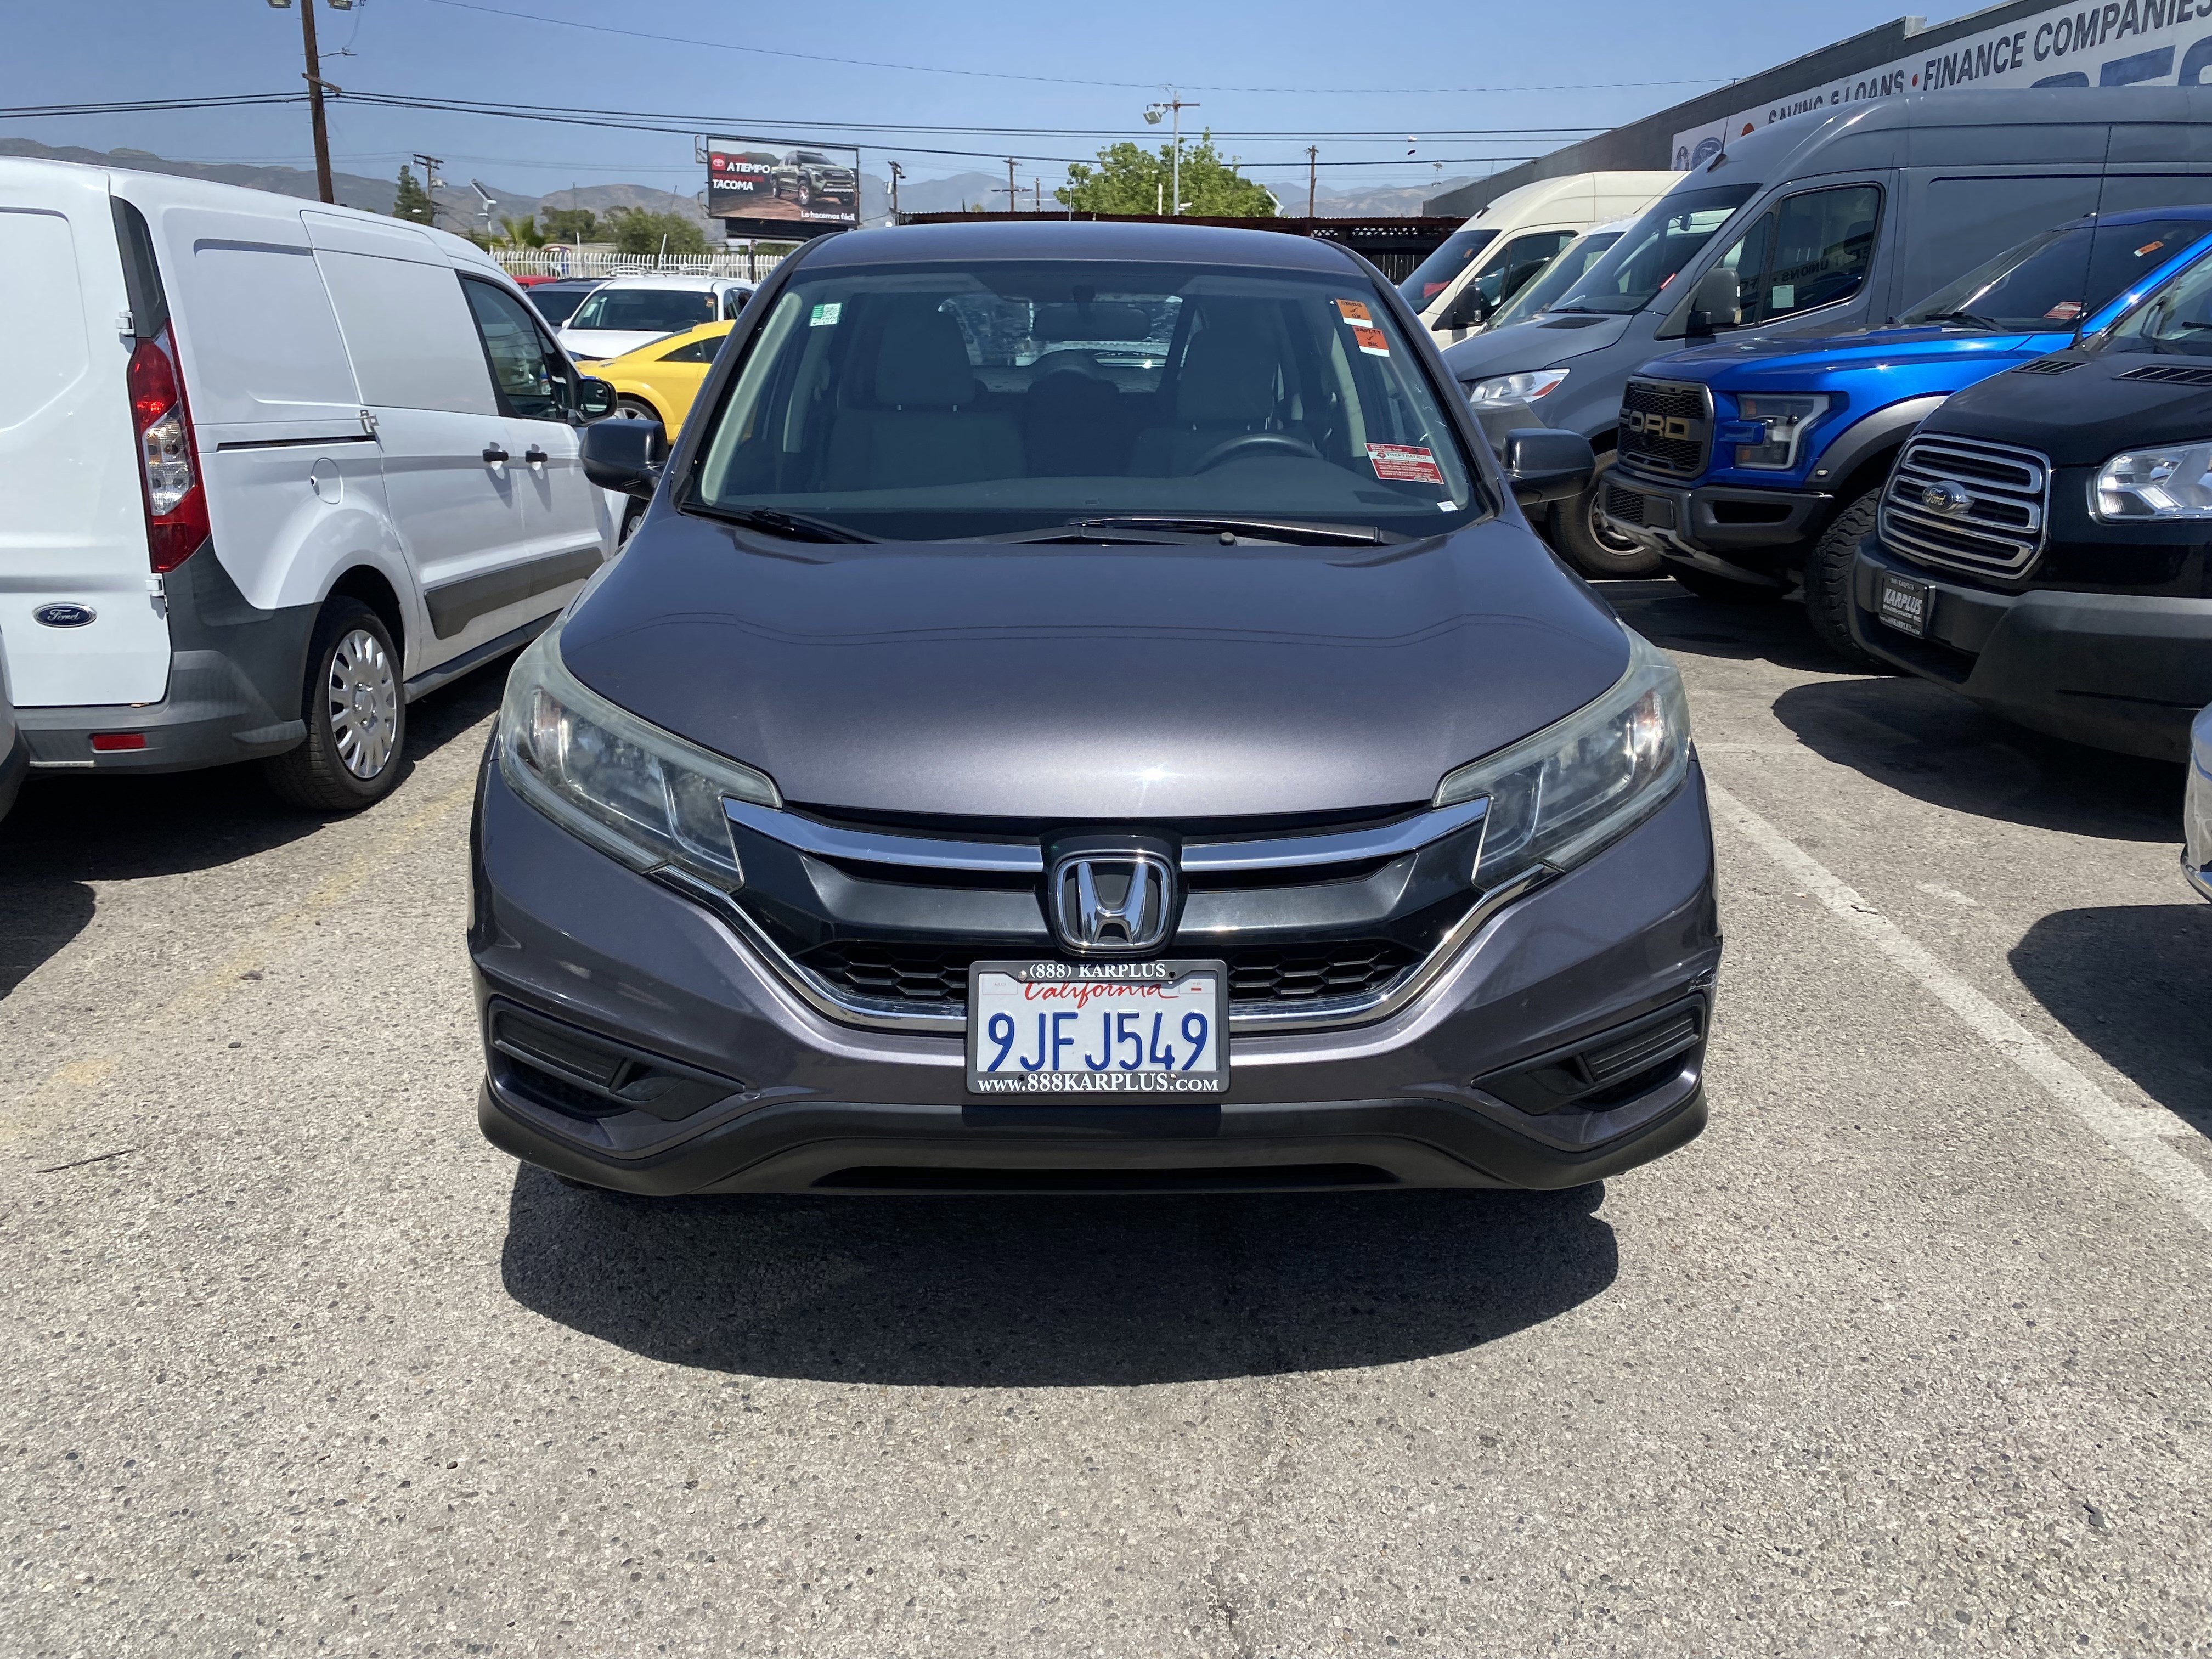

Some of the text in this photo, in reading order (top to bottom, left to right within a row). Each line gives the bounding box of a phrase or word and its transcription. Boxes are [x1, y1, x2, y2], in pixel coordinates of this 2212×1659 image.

[1845, 69, 1904, 103] LOANS
[1923, 31, 2027, 91] FINANCE
[727, 162, 770, 174] A TIEMPO
[713, 179, 753, 191] TACOMA
[810, 211, 840, 219] hacemos
[1925, 488, 1946, 506] Ford
[1883, 588, 1923, 615] KARPLUS
[47, 608, 80, 621] Ford
[1029, 963, 1166, 978] (888) KARPLUS
[1024, 981, 1179, 1009] California
[987, 1011, 1208, 1072] 9JFJ549
